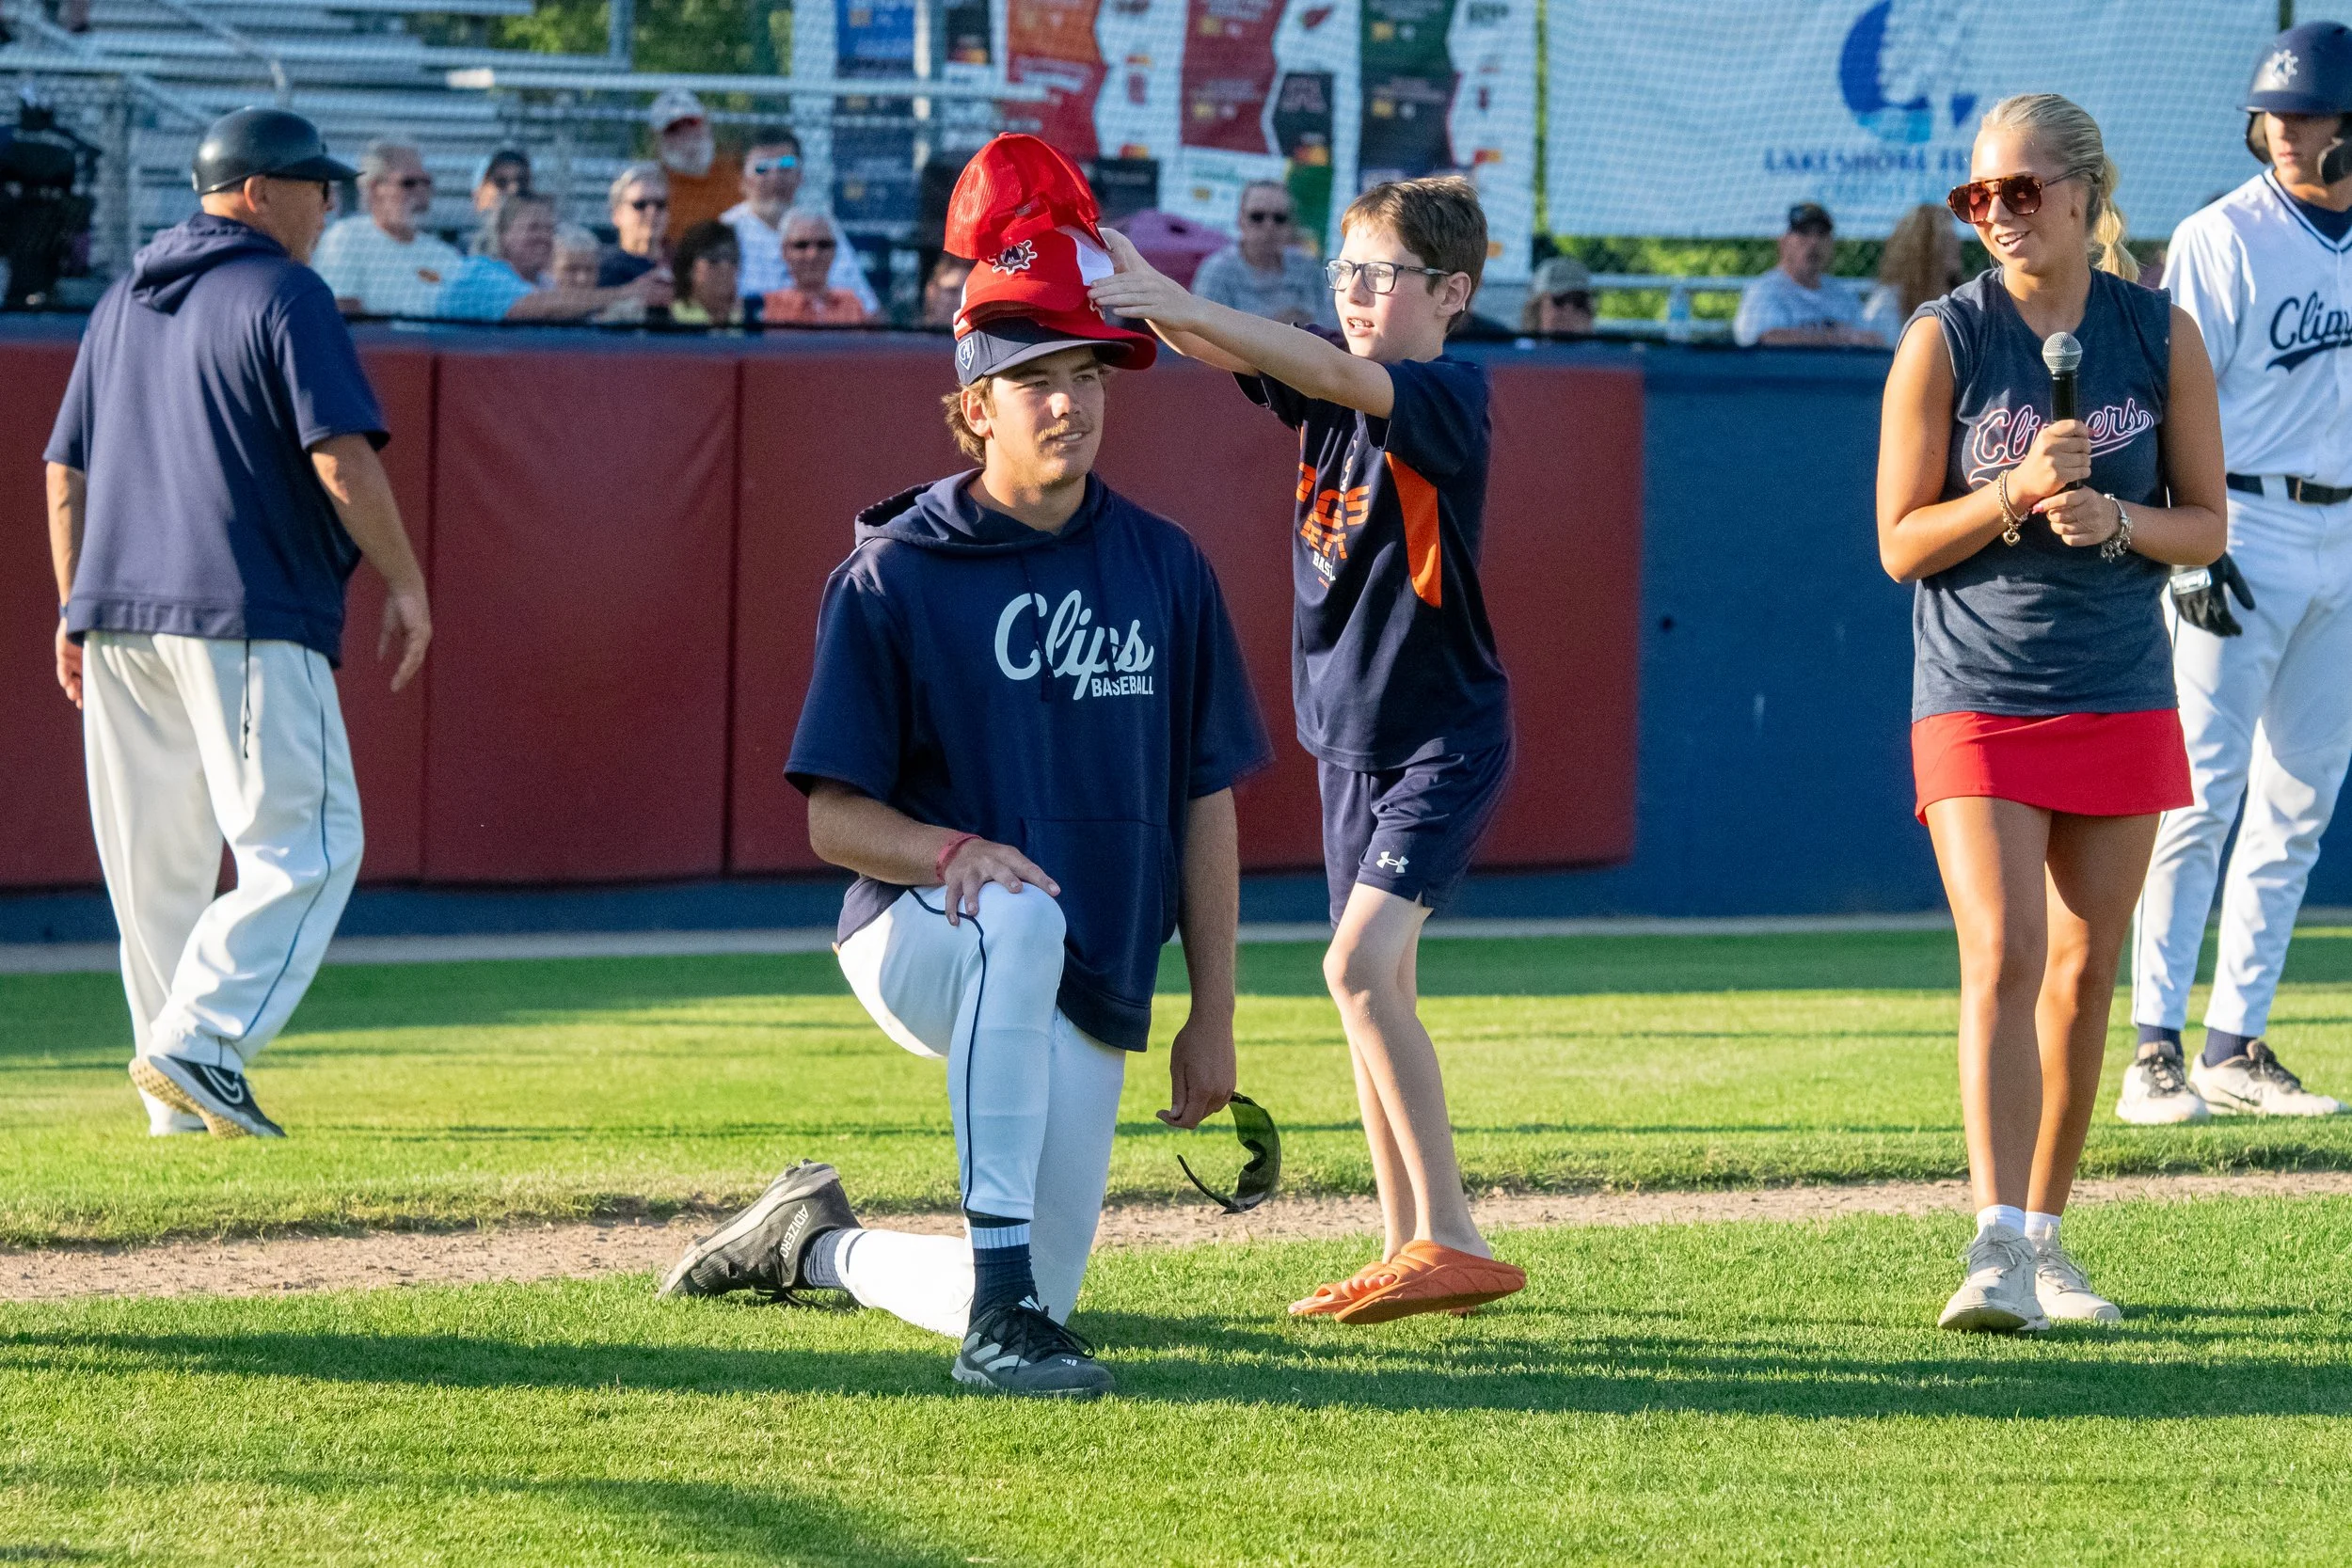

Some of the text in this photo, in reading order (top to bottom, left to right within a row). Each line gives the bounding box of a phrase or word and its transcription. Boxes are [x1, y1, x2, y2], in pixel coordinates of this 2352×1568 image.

[1973, 397, 2154, 467] Cliers
[993, 589, 1155, 701] Clips
[1090, 674, 1154, 698] BASEBALL
[779, 1203, 809, 1259] ADIZERO
